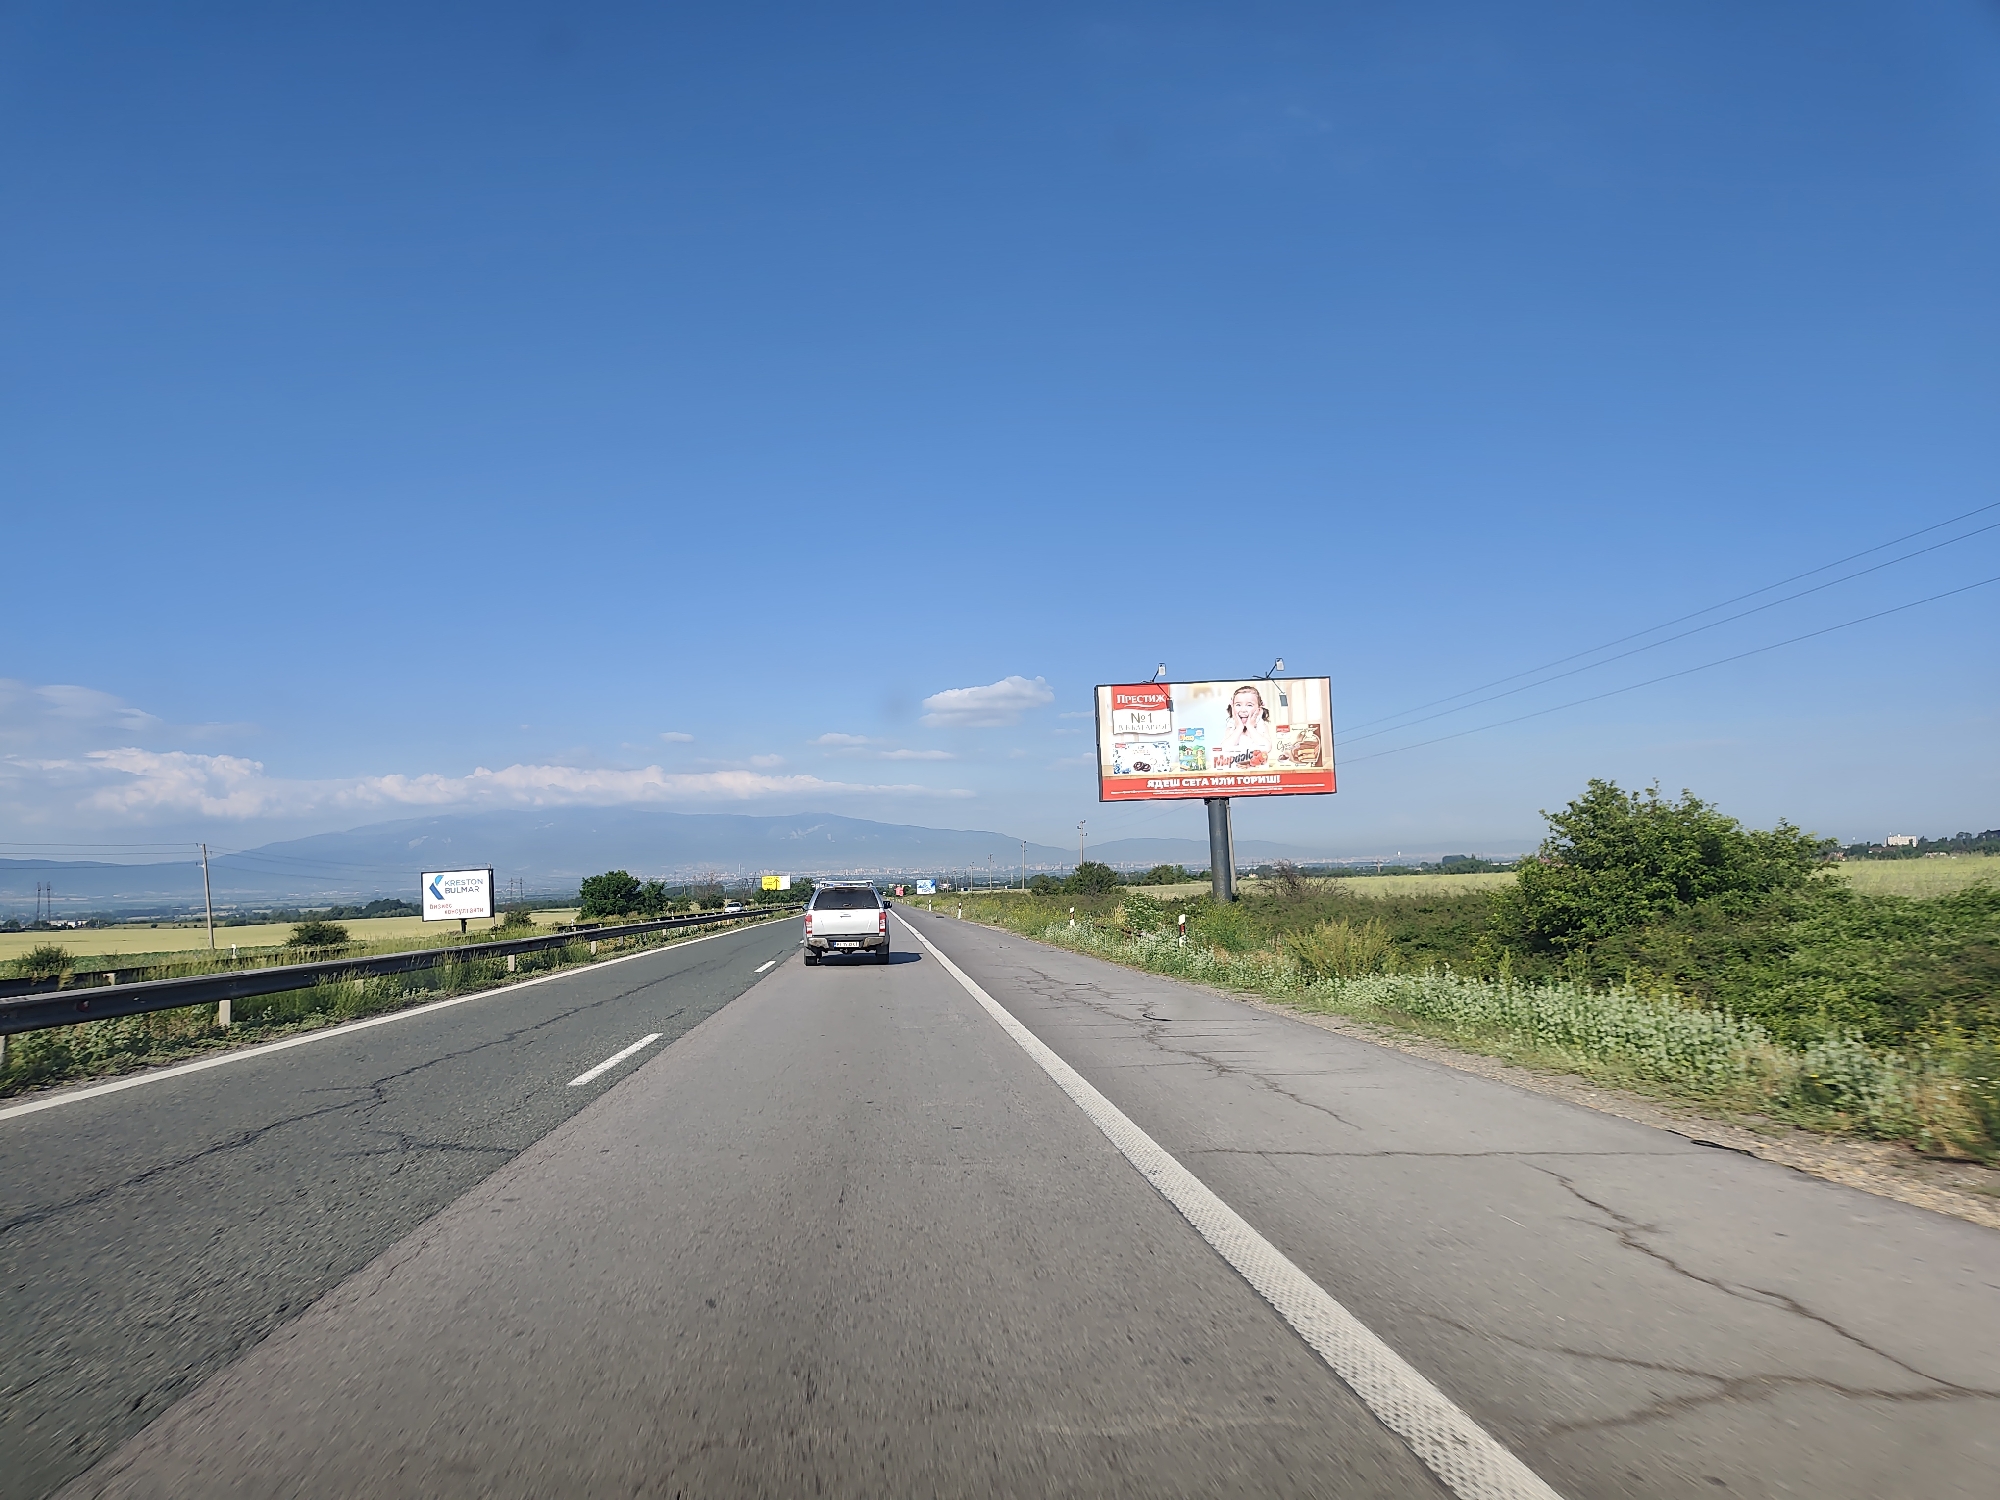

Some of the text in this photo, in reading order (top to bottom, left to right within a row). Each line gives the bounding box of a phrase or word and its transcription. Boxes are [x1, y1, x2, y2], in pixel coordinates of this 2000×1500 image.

[1117, 694, 1165, 704] ПРЕСТИЖ
[1147, 779, 1180, 788] ЯДЕШ
[1210, 776, 1235, 785] ИЛИ
[1236, 775, 1280, 784] ГОРИШ!
